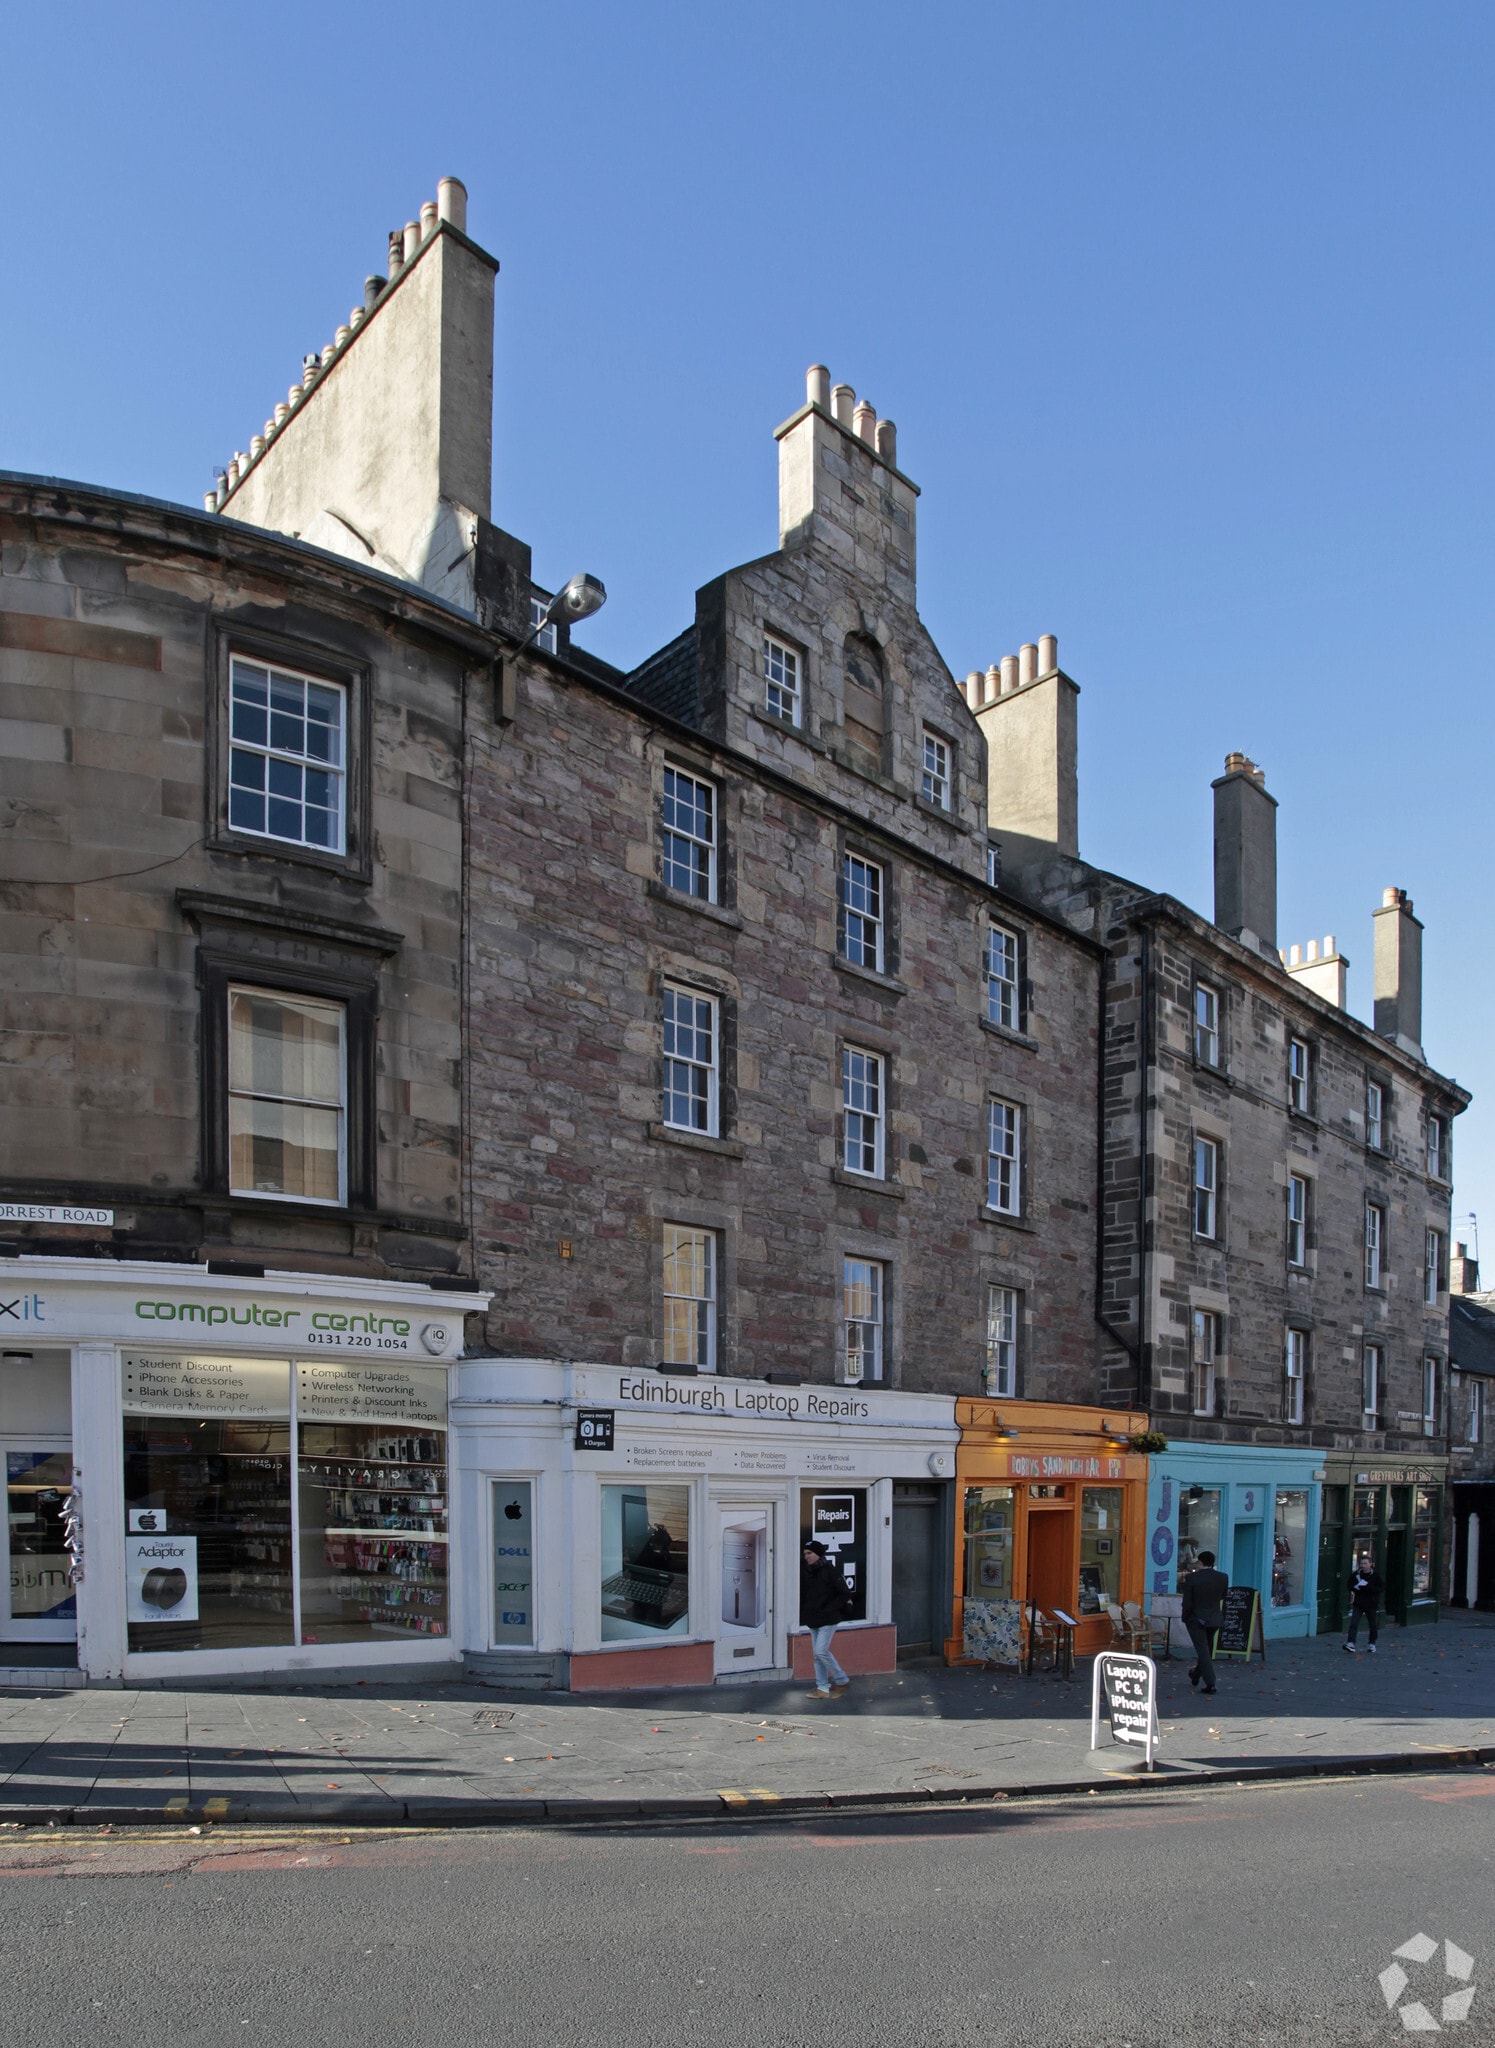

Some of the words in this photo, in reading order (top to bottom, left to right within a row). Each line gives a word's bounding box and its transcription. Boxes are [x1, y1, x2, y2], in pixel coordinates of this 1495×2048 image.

[63, 1209, 108, 1223] ROAD
[135, 1301, 300, 1328] computer
[311, 1312, 411, 1337] centre
[308, 1333, 341, 1345] 0131
[347, 1336, 372, 1347] 220
[376, 1338, 408, 1350] 1054
[433, 1330, 444, 1340] iQ
[139, 1358, 182, 1370] Student
[186, 1361, 233, 1373] Discount
[139, 1373, 177, 1384] iPhone
[181, 1375, 244, 1387] Accessories
[311, 1368, 361, 1380] Computer
[364, 1371, 410, 1382] Upgrades
[139, 1386, 169, 1397] Blank
[173, 1388, 202, 1398] Disks
[205, 1389, 215, 1399] &
[219, 1390, 250, 1402] Paper
[311, 1381, 354, 1392] Wireless
[358, 1383, 415, 1396] Networking
[311, 1394, 349, 1405] Printers
[352, 1396, 361, 1405] &
[364, 1397, 406, 1408] Discount
[409, 1398, 428, 1408] Inks
[619, 1378, 726, 1411] Edinburgh
[735, 1388, 800, 1414] Laptop
[807, 1394, 869, 1418] Repairs
[140, 1400, 183, 1411] Camera
[188, 1402, 236, 1413] Memory
[239, 1404, 269, 1415] Cards
[311, 1407, 335, 1417] New
[338, 1408, 347, 1417] &
[351, 1409, 369, 1418] 2nd
[372, 1410, 398, 1420] Hand
[401, 1411, 438, 1421] Laptops
[633, 1446, 657, 1455] Broken
[659, 1447, 684, 1456] Screens
[685, 1449, 713, 1457] replaced
[740, 1451, 759, 1459] Power
[760, 1451, 787, 1460] Problems
[827, 1454, 849, 1462] Removal
[633, 1457, 676, 1467] Replacement
[677, 1460, 706, 1468] batteries
[740, 1461, 755, 1469] Data
[756, 1462, 786, 1470] Recovered
[1042, 1455, 1084, 1478] SANDWICH
[1085, 1456, 1100, 1478] BAR
[1370, 1470, 1404, 1482] GREYFRIARS
[1405, 1470, 1418, 1482] ART
[1244, 1490, 1255, 1512] 3
[817, 1508, 850, 1523] iRepairs
[137, 1546, 187, 1560] Adaptor
[497, 1547, 530, 1557] DELL
[497, 1582, 531, 1593] acer
[1106, 1663, 1148, 1682] Laptop
[1115, 1680, 1132, 1694] PC
[1133, 1683, 1144, 1696] &
[1111, 1694, 1150, 1712] iPhone
